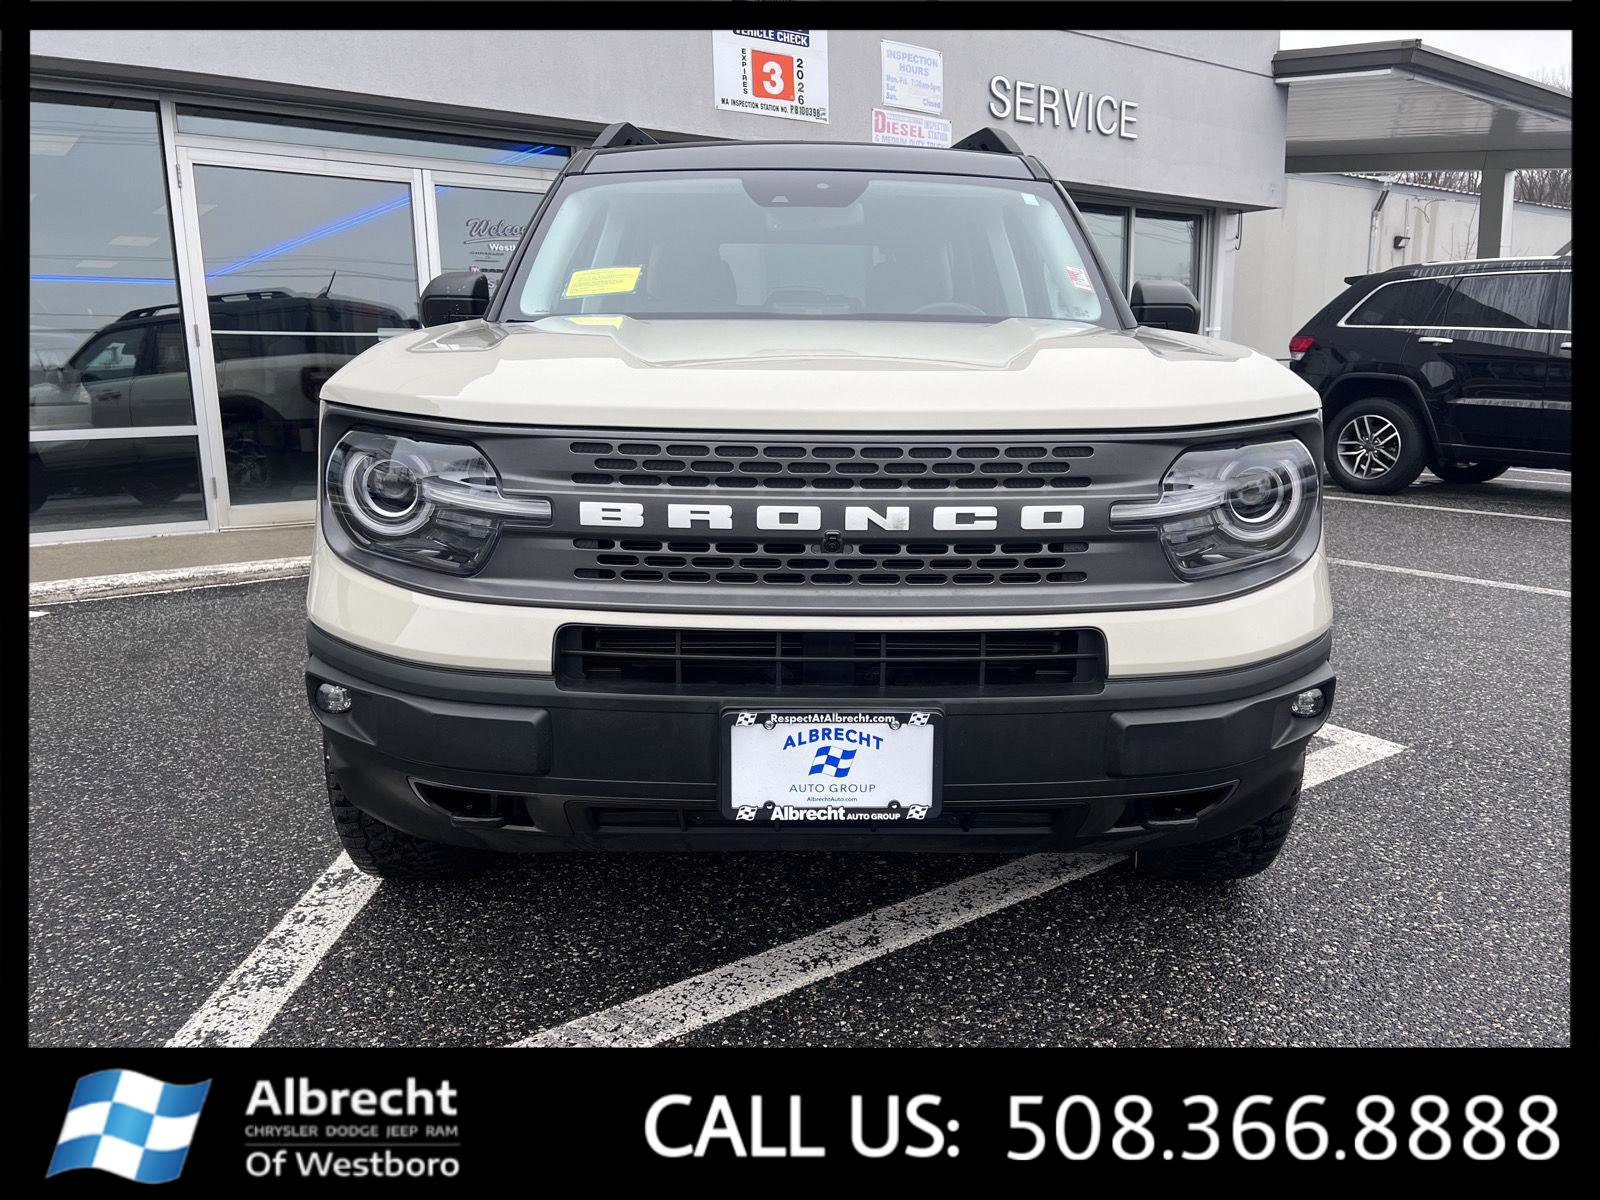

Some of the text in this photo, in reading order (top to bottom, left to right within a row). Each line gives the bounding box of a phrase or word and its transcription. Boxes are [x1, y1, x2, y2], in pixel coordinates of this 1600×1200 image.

[776, 31, 809, 47] CHECK
[886, 49, 939, 68] INSPECTION
[762, 61, 785, 95] 3
[899, 63, 929, 77] HOURS
[796, 58, 805, 106] 2026
[721, 98, 730, 106] MA
[731, 100, 759, 110] INSPECTION
[760, 103, 780, 112] STATION
[989, 75, 1139, 141] SERVICE
[580, 502, 1085, 531] BRONCO
[770, 713, 895, 724] RespectAtAlbrecht.com
[783, 727, 884, 750] ALBRECHT
[788, 784, 876, 793] AUTO GROUP
[770, 805, 846, 821] Albrecht
